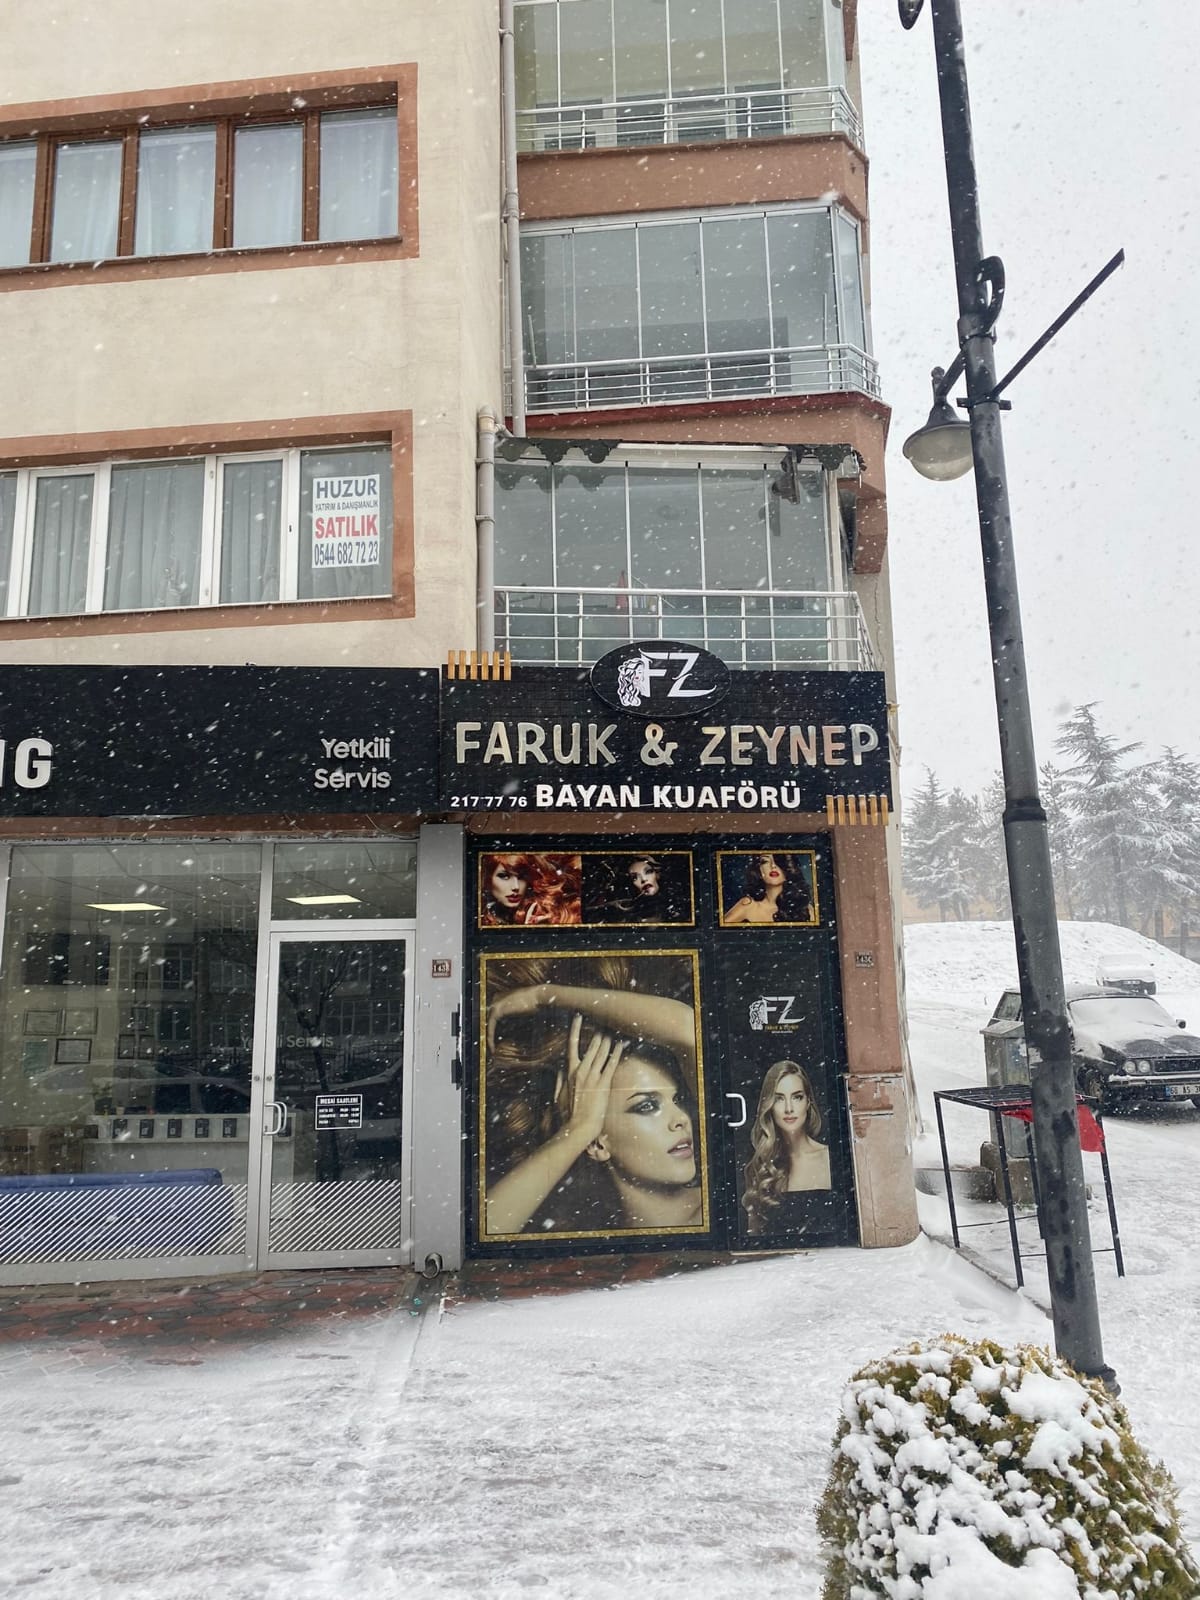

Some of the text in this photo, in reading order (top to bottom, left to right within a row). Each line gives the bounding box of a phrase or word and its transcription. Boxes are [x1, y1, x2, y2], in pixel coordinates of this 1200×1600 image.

[316, 478, 377, 499] HUZUR
[315, 514, 378, 539] SATILIK
[314, 540, 378, 566] 0544 682 72 23
[639, 649, 717, 697] FZ
[321, 737, 391, 759] Yetkili
[456, 722, 879, 766] FARUK & ZEYNEP
[0, 738, 54, 789] G
[314, 767, 391, 789] Servis
[450, 796, 528, 807] 217 77 76
[535, 780, 801, 808] BAYAN KUAFÖRÜ
[760, 995, 806, 1024] FZ
[286, 1033, 334, 1048] Seris
